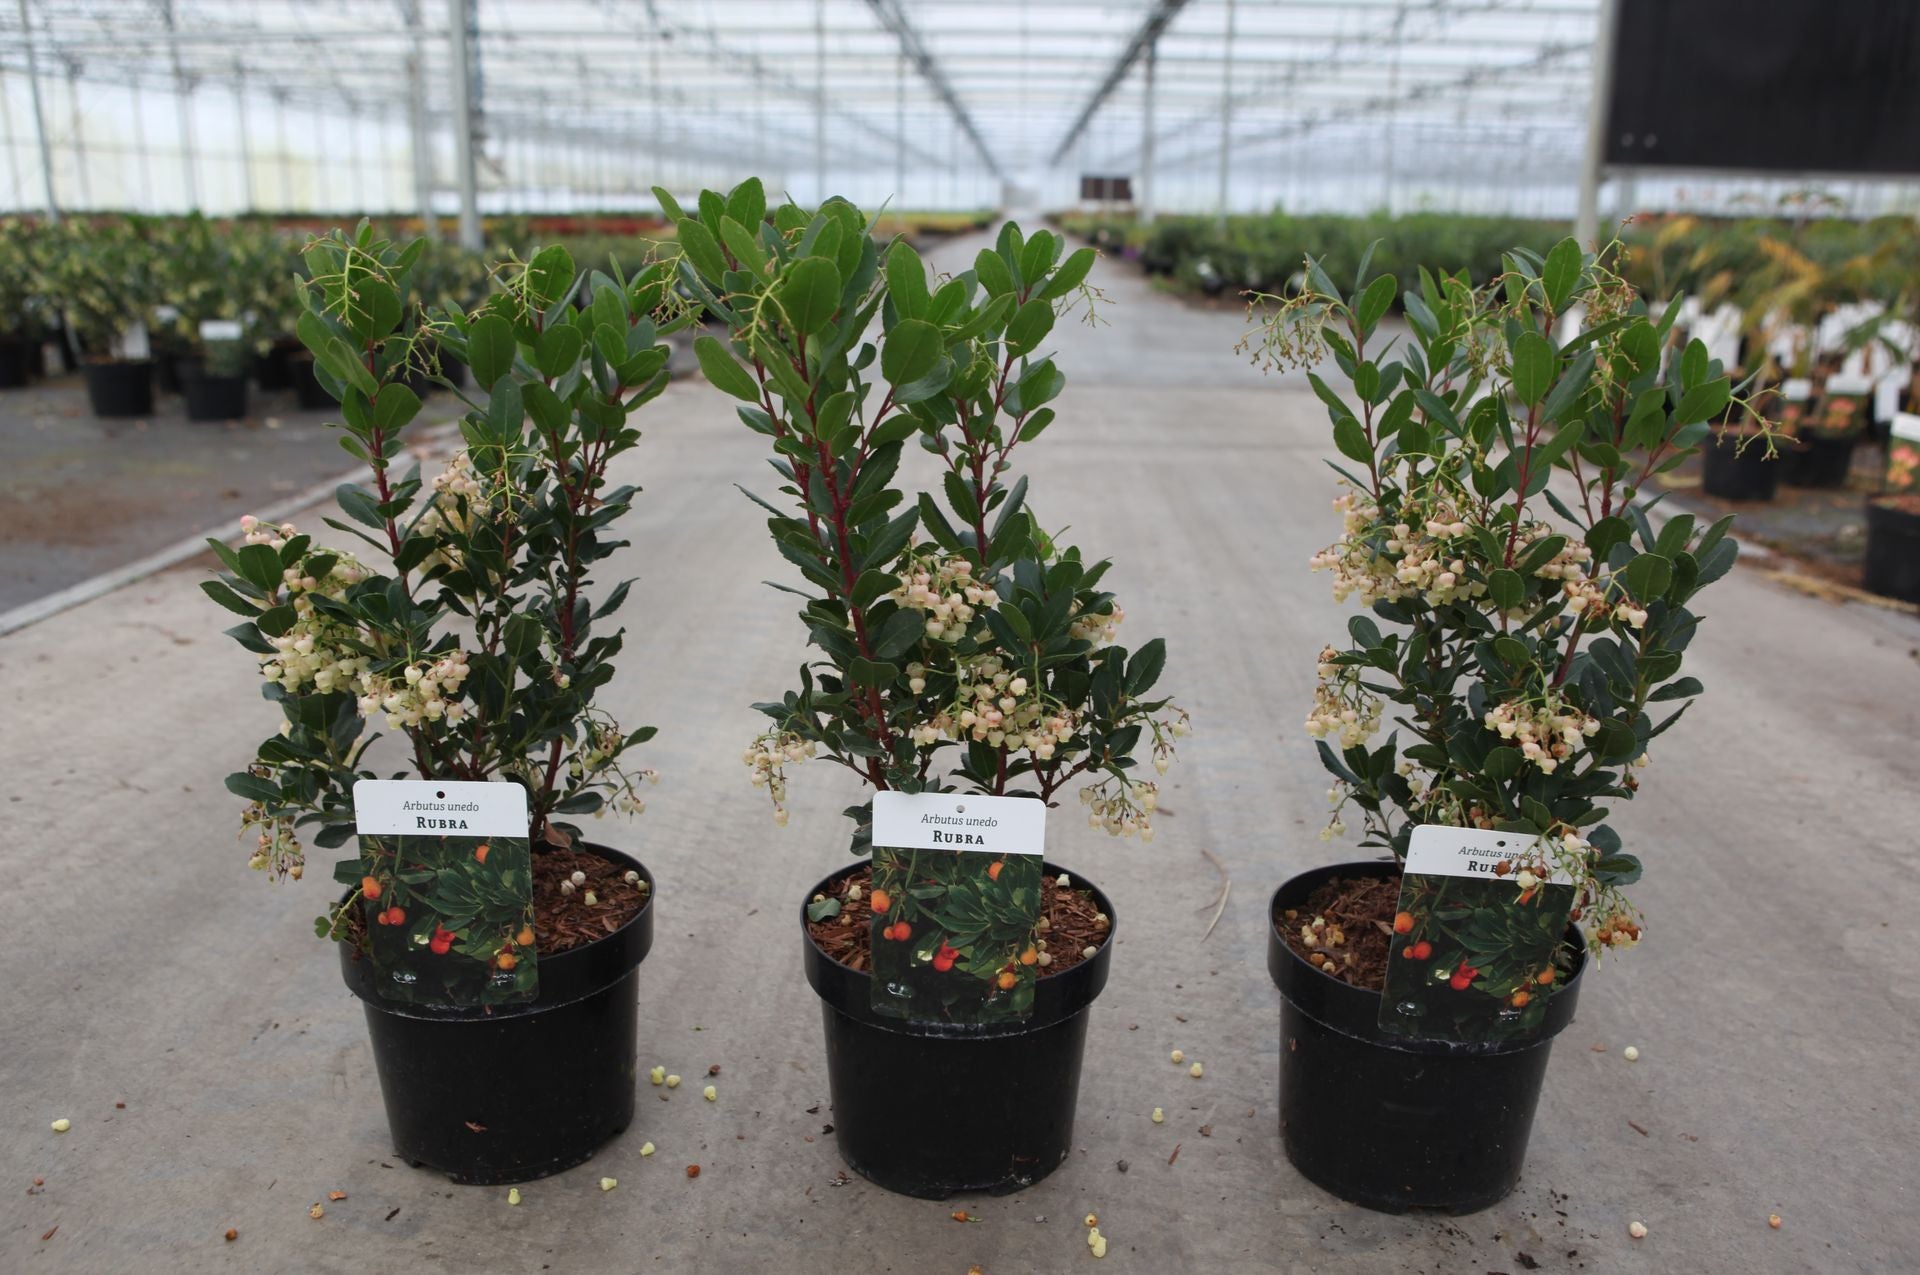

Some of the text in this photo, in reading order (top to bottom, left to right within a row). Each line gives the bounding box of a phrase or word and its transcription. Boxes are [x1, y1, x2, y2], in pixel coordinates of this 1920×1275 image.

[403, 800, 480, 812] Arbutus unedo
[416, 816, 468, 830] RUBRA
[921, 813, 998, 828] Arbutus unedo
[933, 830, 985, 845] RUBRA
[1458, 846, 1503, 858] Arbutus
[1467, 860, 1520, 875] RUBA
